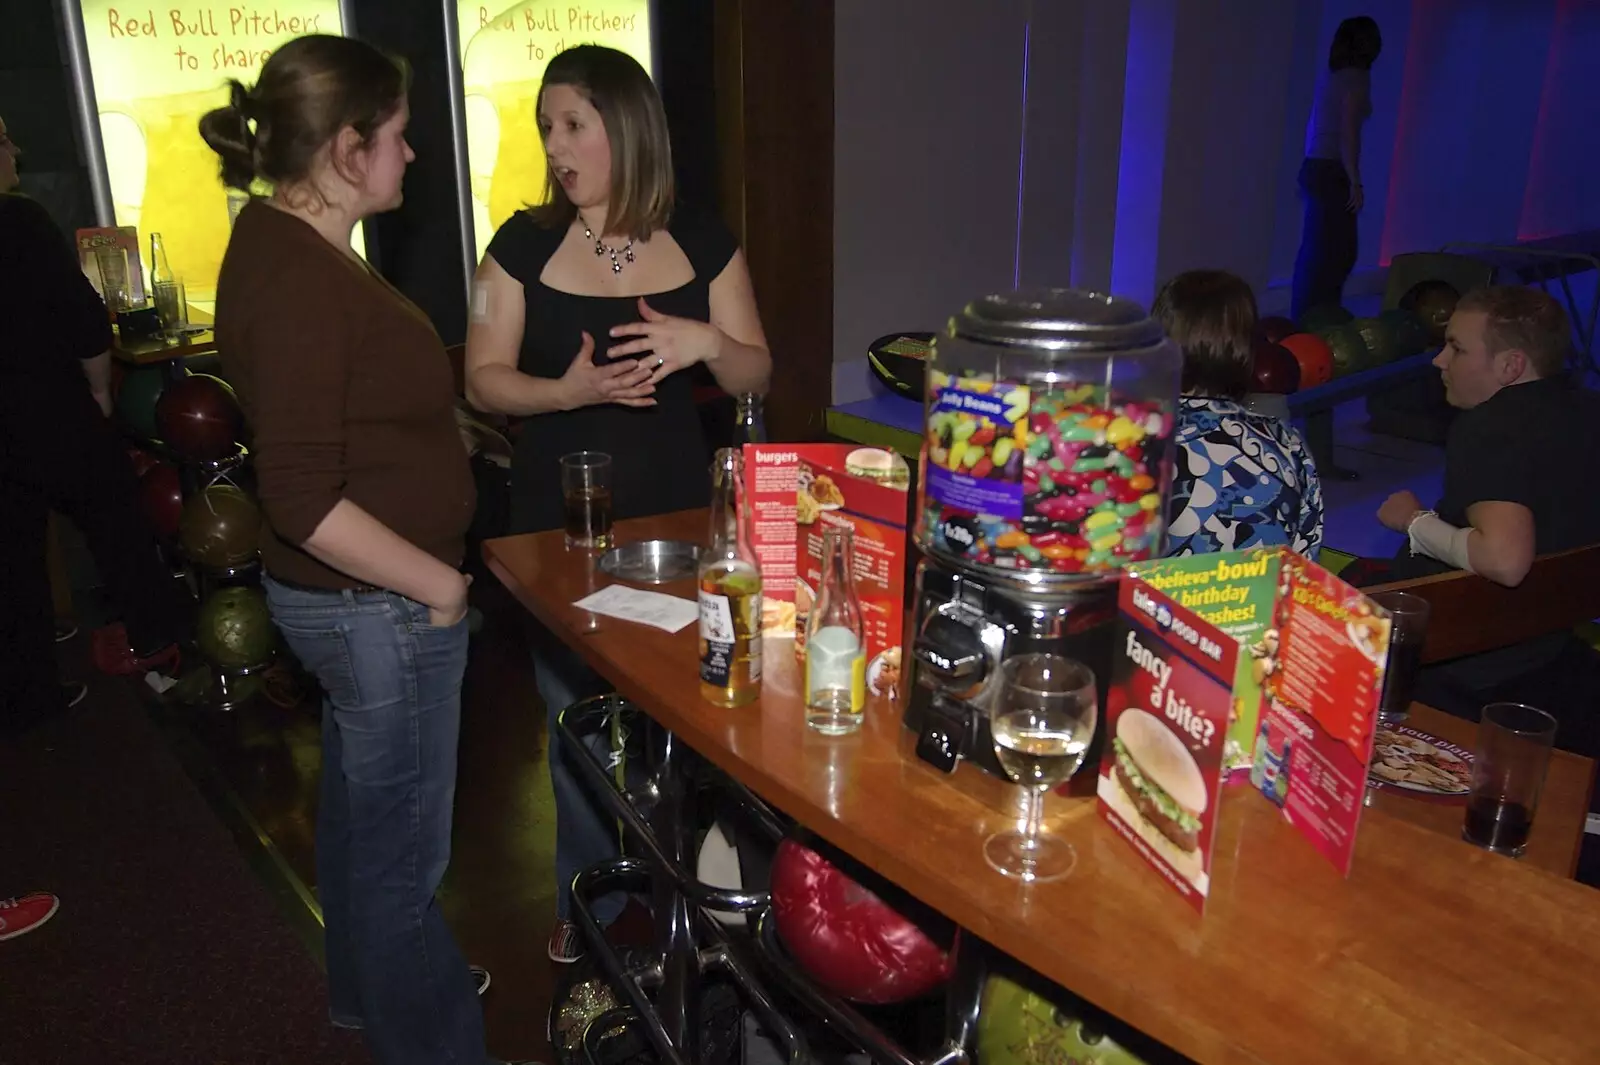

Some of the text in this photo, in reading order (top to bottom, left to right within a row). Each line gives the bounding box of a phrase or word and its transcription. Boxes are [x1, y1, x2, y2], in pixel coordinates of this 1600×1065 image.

[108, 6, 320, 38] Red Bull Pitchers
[524, 8, 560, 32] Bull
[568, 6, 636, 33] Pitchers
[174, 45, 198, 71] to
[526, 38, 545, 61] to
[963, 395, 1002, 415] Beans
[754, 449, 799, 466] burgers
[1180, 584, 1250, 608] birthday
[1126, 630, 1173, 690] fancy
[1150, 684, 1164, 709] a
[1398, 725, 1476, 764] your platt
